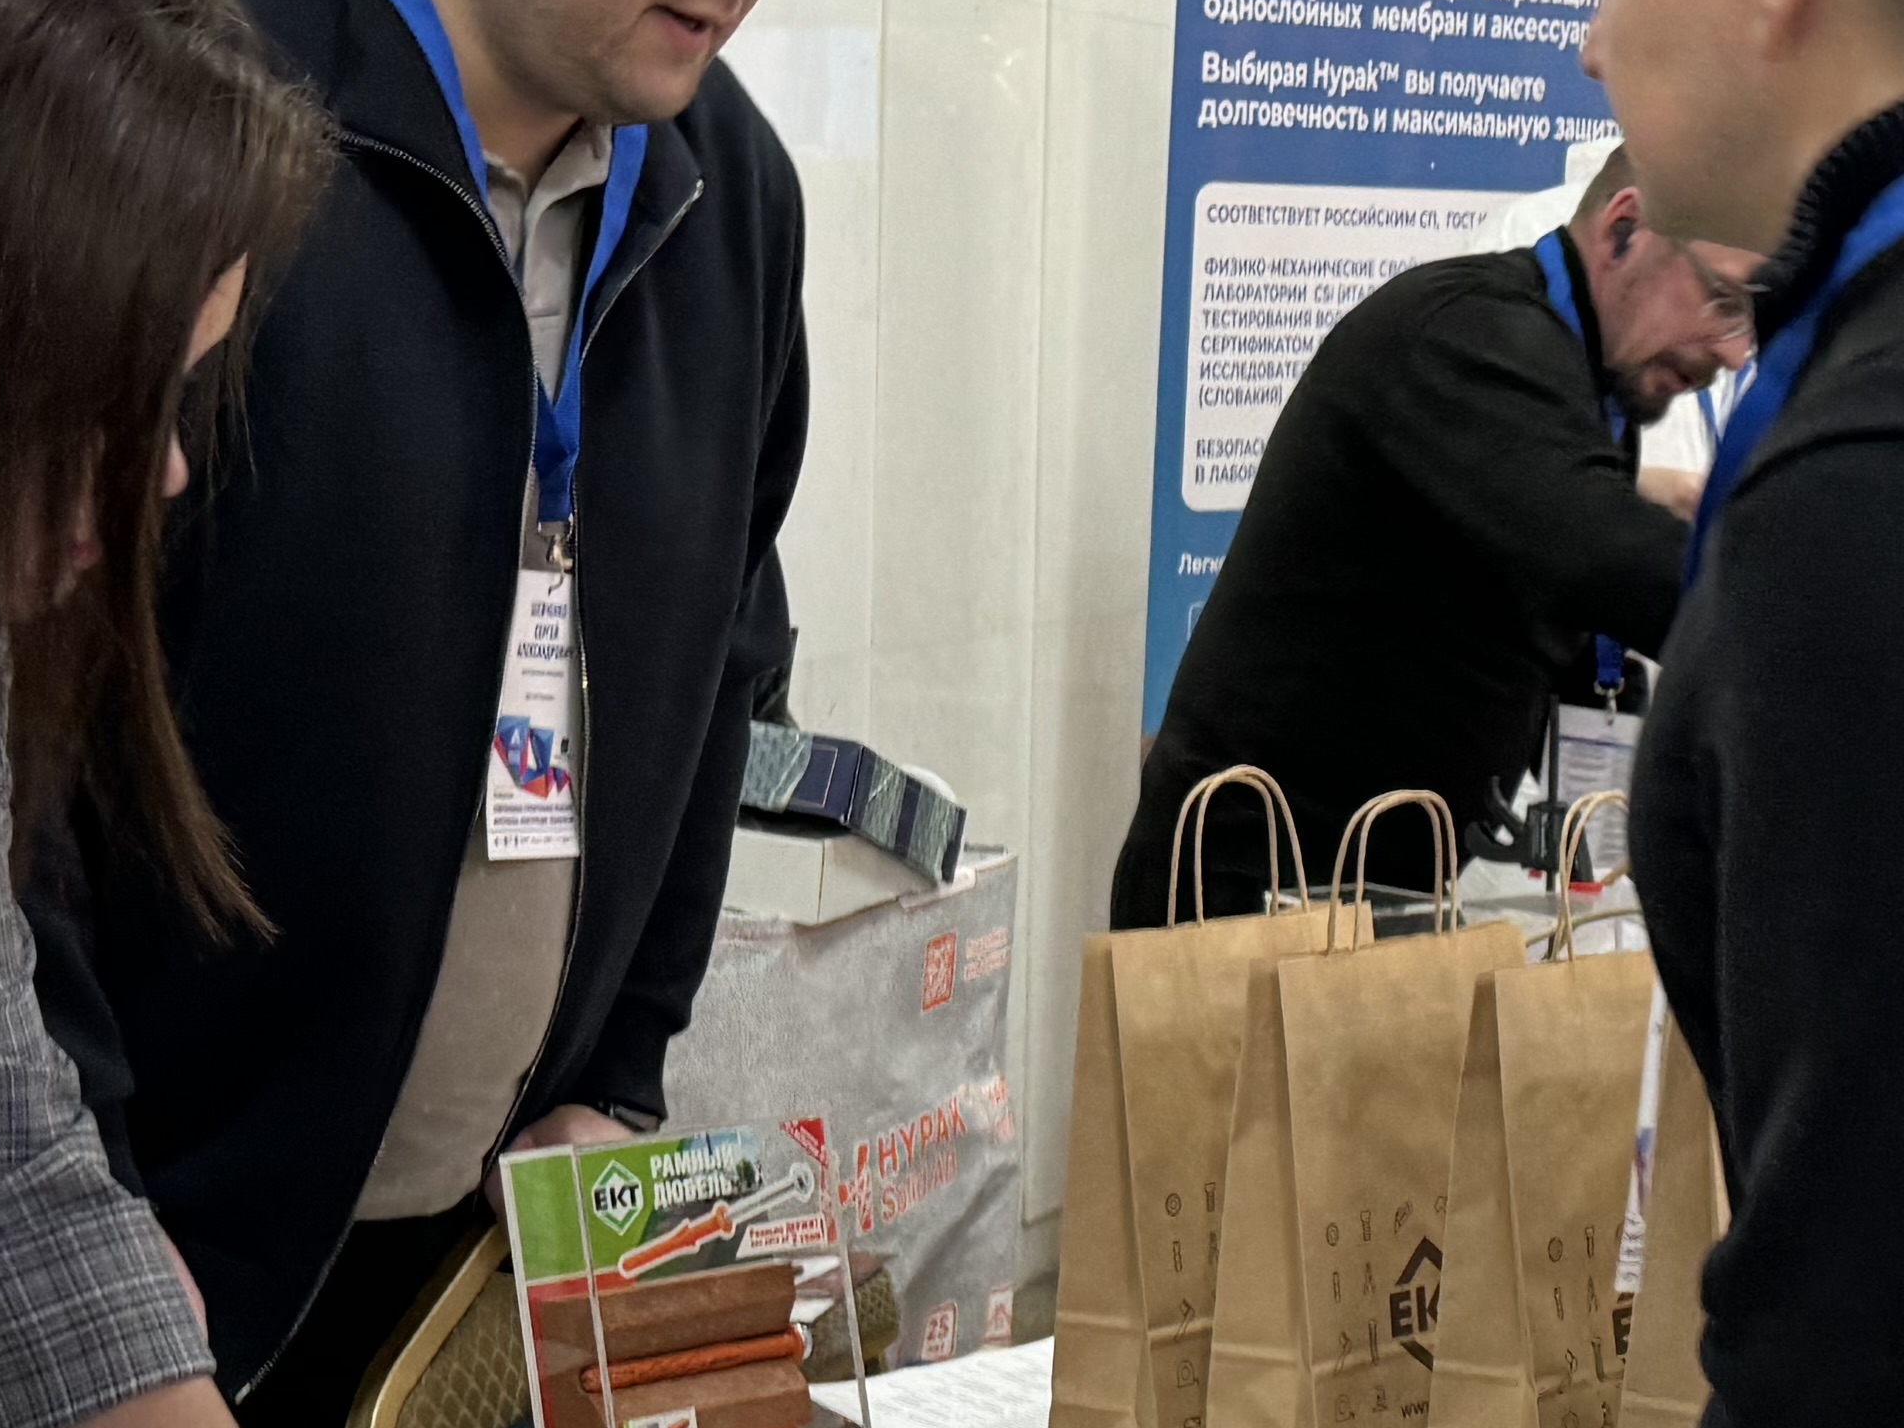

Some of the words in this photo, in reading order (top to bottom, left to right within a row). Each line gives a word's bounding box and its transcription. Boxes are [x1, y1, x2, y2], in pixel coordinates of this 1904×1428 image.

[1371, 0, 1468, 43] мембран
[1471, 12, 1487, 39] и
[1201, 49, 1309, 94] Выбирая
[1404, 68, 1436, 97] вы
[1439, 70, 1546, 106] получаете
[1197, 98, 1370, 130] долговечность
[1372, 106, 1388, 134] и
[1392, 108, 1551, 147] максимальную
[1207, 203, 1321, 227] СООТВЕТСТВУЕТ
[1324, 205, 1416, 229] РОССИЙСКИМ
[1204, 256, 1375, 279] ФИЗИКО-МЕХАНИЧЕСКИЕ
[1203, 282, 1308, 303] ЛАБОРАТОРИИ
[1202, 309, 1312, 329] ТЕСТИРОВАНИЯ
[1200, 334, 1314, 355] СЕРТИФИКАТОМ
[1198, 385, 1283, 409] (СЛОВАКИЯ)
[877, 1094, 966, 1180] HYPAK
[649, 1143, 736, 1180] РАМНЫЙ
[594, 1180, 641, 1214] EKT
[653, 1172, 733, 1210] ДЮБЕЛЬ
[1390, 1285, 1439, 1340] EK
